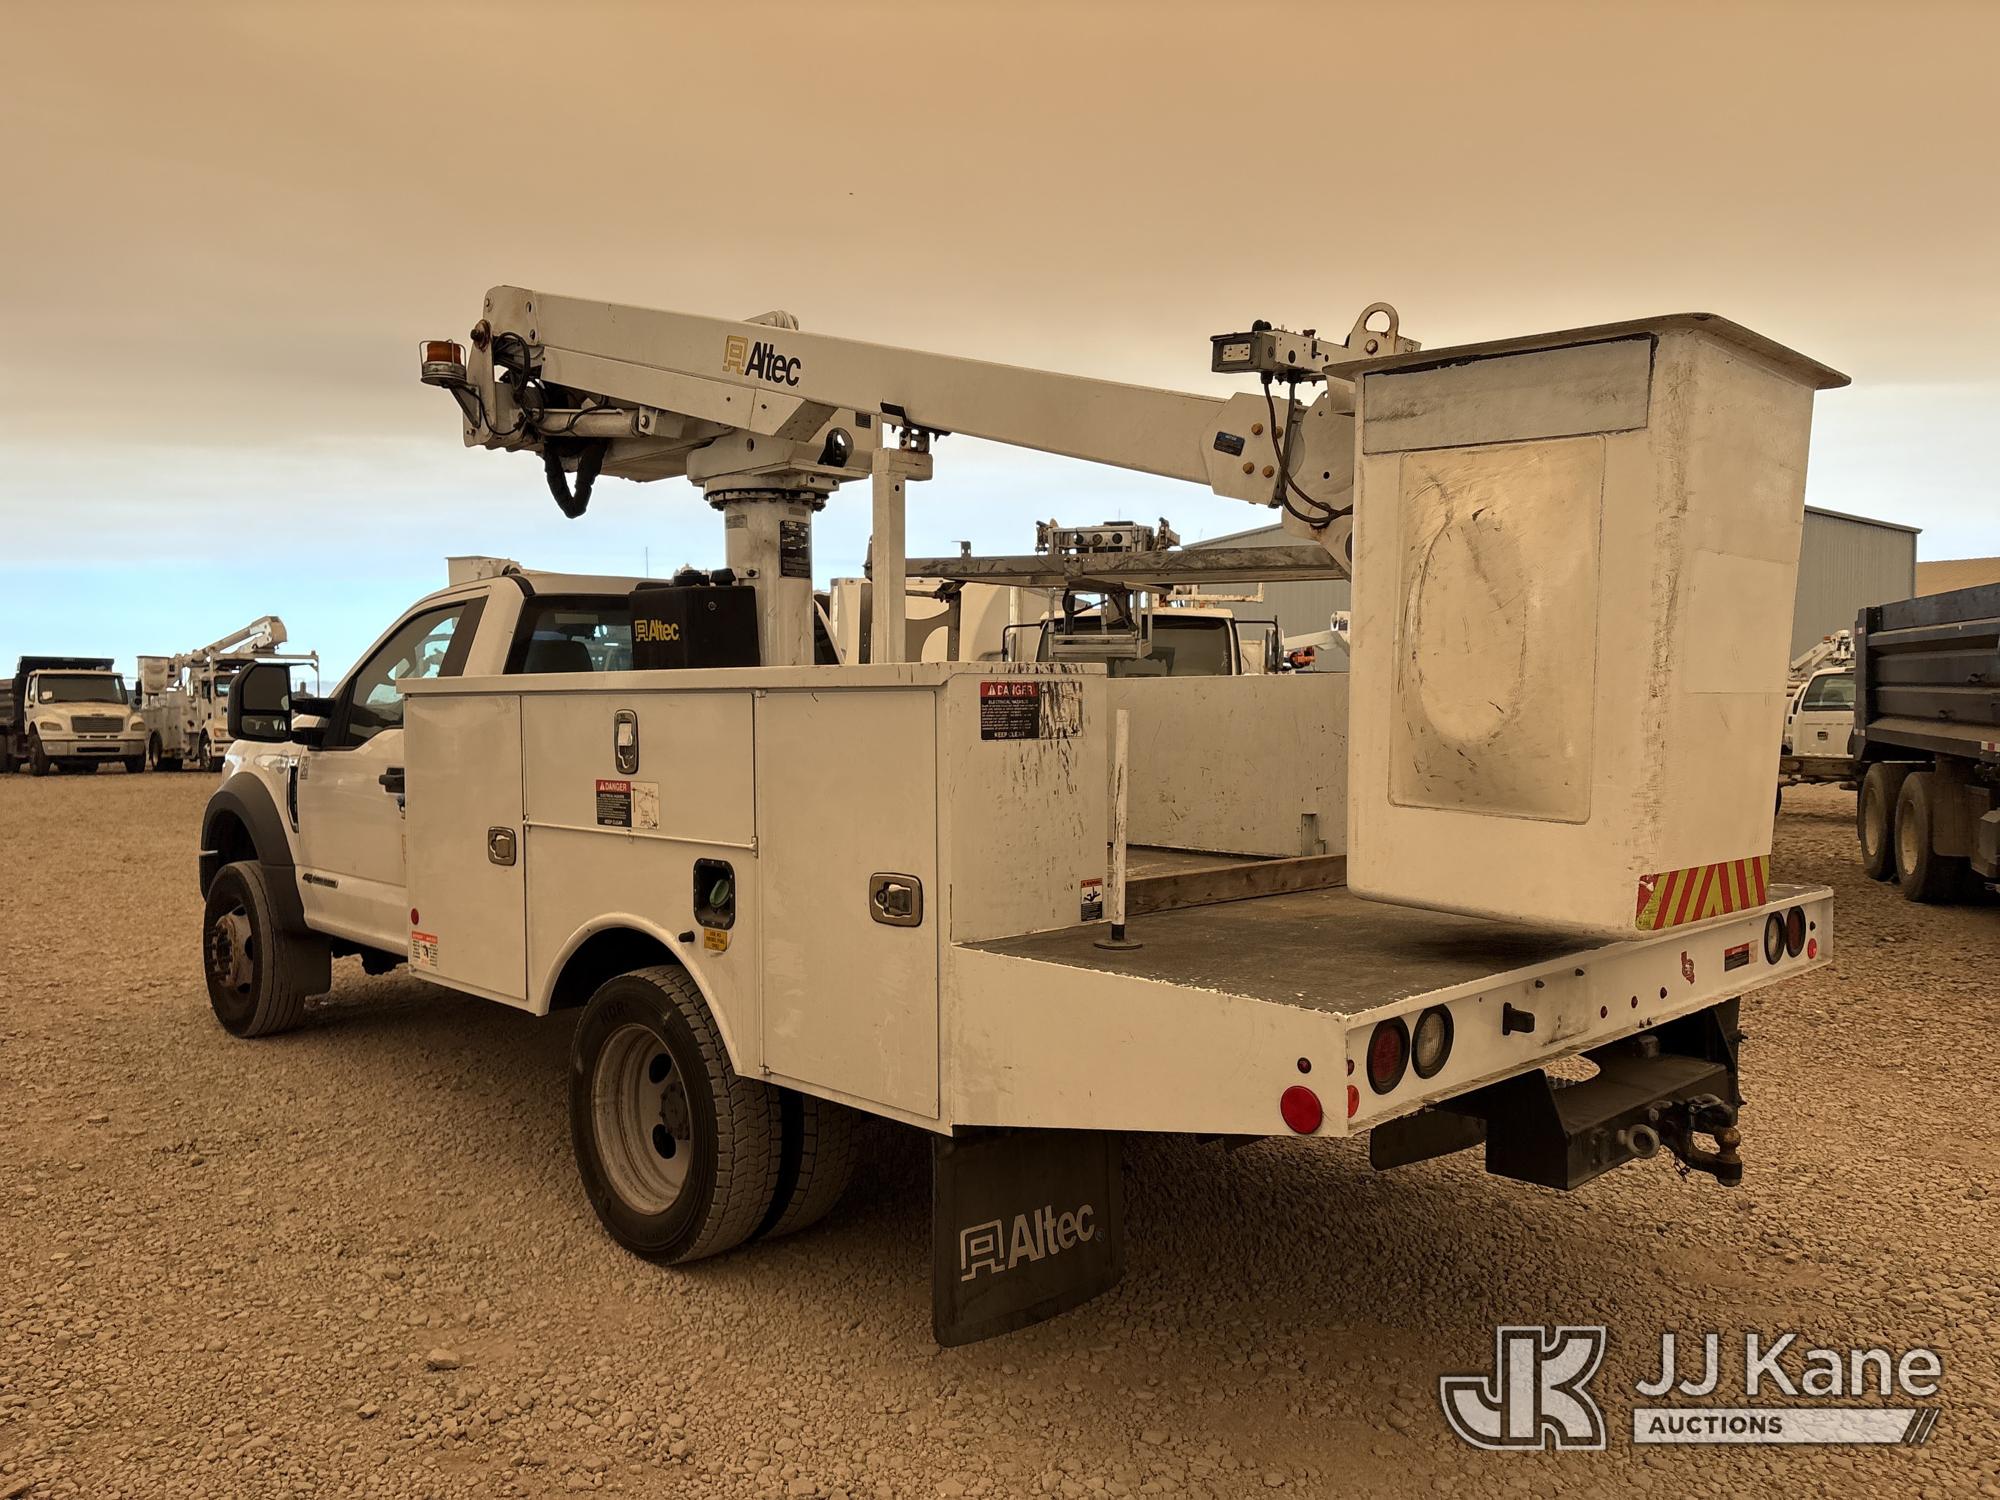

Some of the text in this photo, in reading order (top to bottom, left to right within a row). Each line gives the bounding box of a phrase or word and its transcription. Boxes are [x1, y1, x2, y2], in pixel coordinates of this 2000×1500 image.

[744, 341, 801, 387] Altec
[649, 619, 679, 641] Altec
[605, 783, 627, 792] DANGER
[1008, 1204, 1095, 1269] Altec
